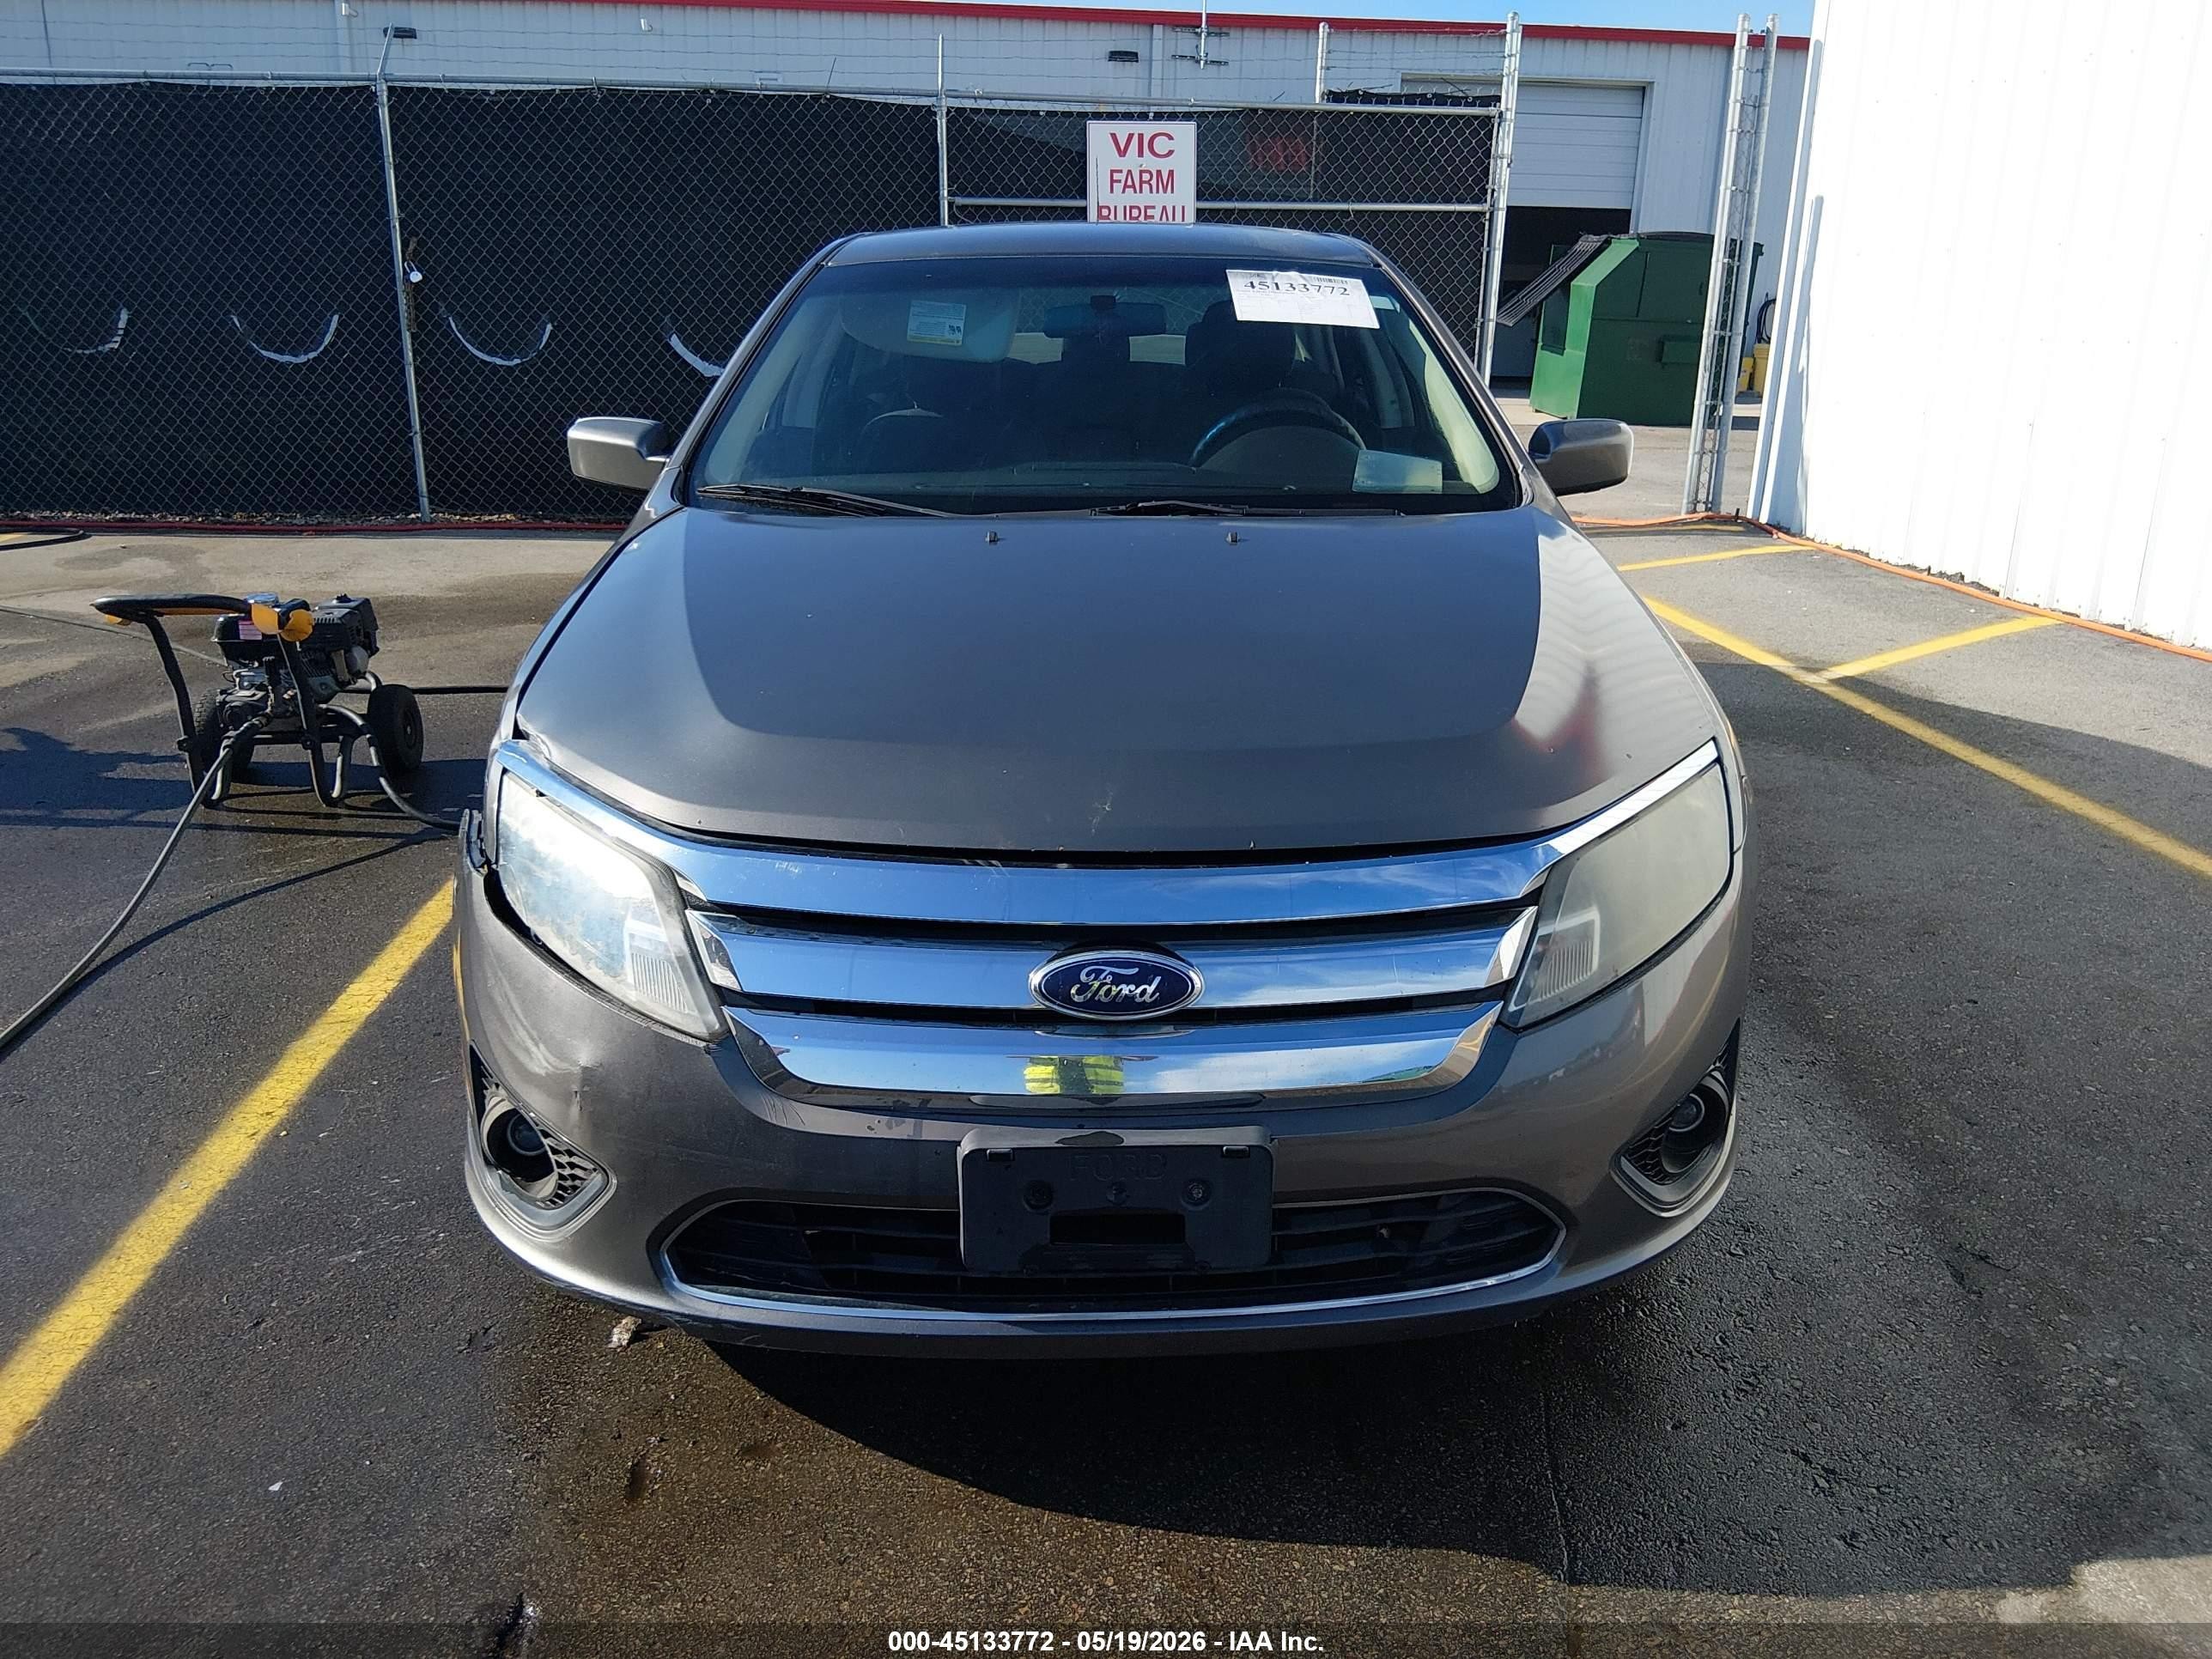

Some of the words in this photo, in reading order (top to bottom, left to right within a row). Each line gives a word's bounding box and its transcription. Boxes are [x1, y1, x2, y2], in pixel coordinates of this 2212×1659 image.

[1109, 132, 1176, 159] VIC
[1109, 168, 1175, 194] FARM
[1243, 280, 1351, 296] 45133772
[1070, 965, 1162, 1003] Ford
[1070, 1153, 1167, 1182] FORD
